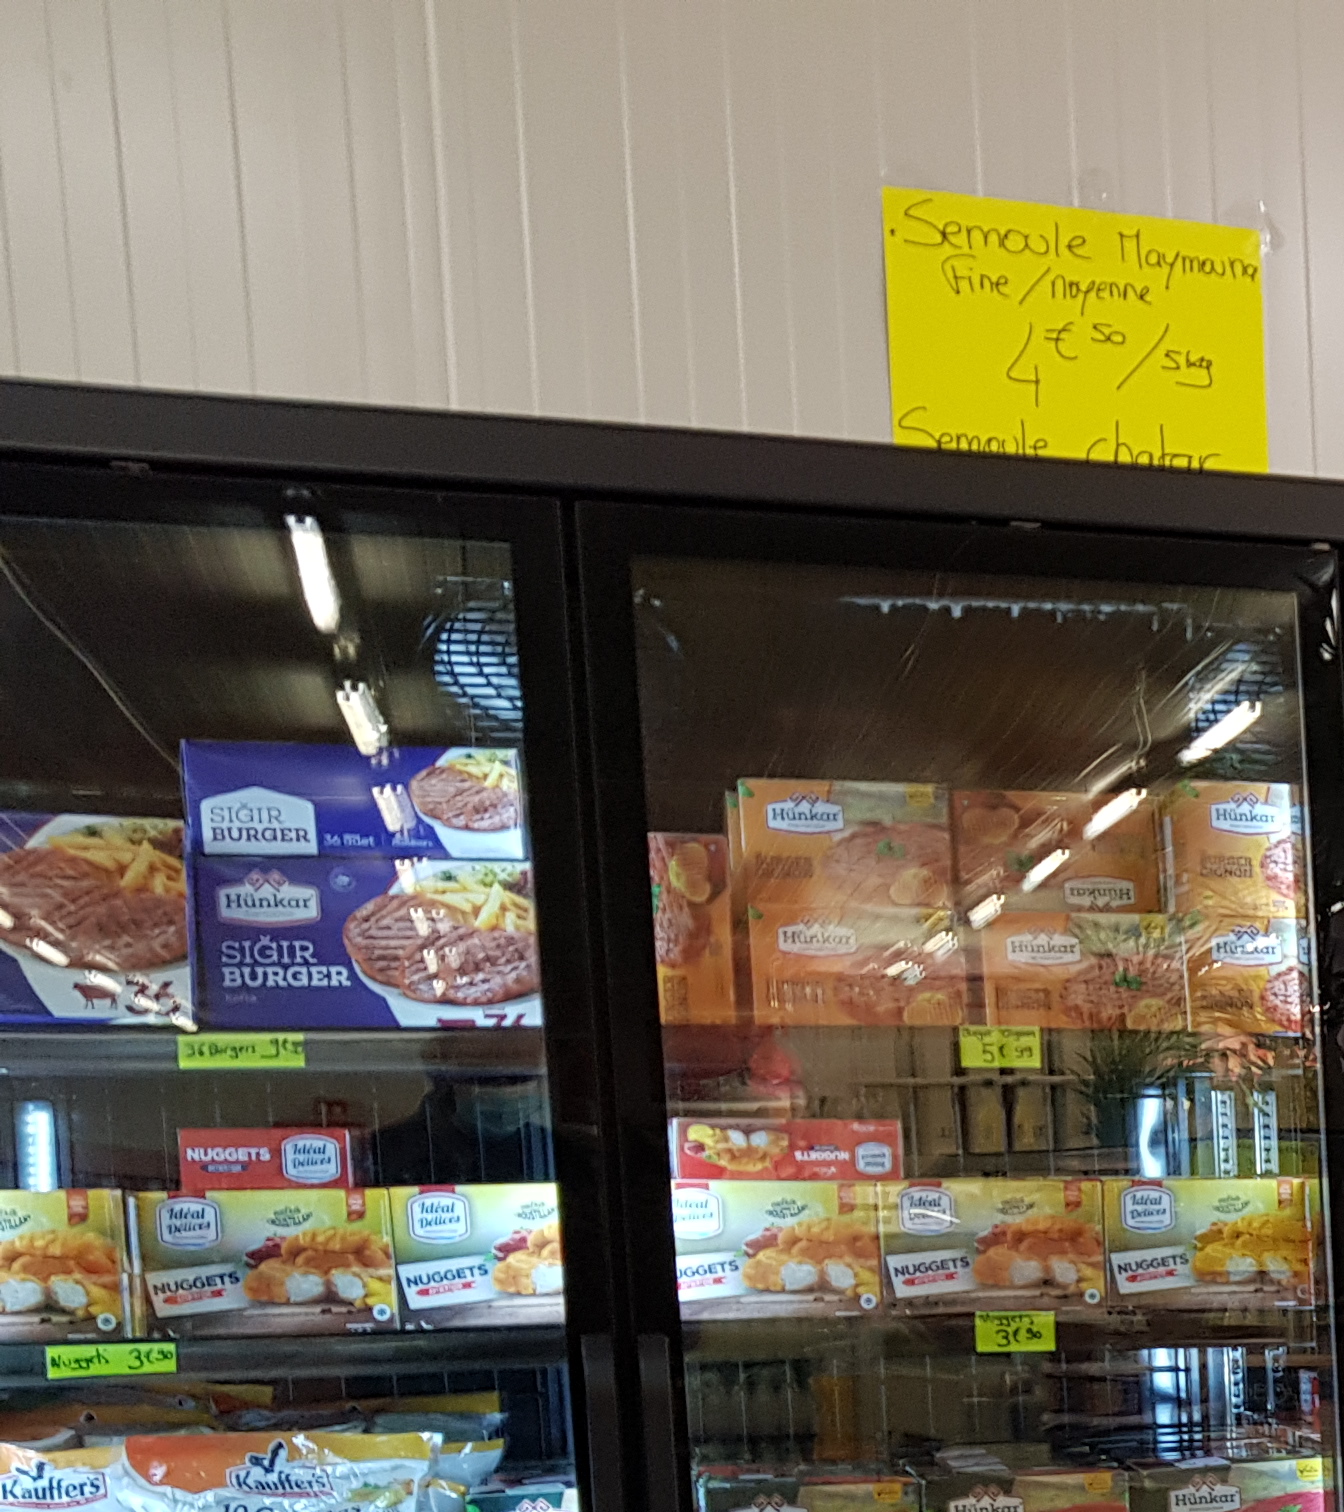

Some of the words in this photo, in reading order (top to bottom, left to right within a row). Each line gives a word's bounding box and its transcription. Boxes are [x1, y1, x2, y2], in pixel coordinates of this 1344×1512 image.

[902, 198, 1092, 260] Semoule
[771, 805, 840, 825] Hünkar
[1212, 807, 1278, 827] Hünkar
[209, 822, 312, 845] BURGER
[224, 886, 313, 912] Hünkar
[1009, 938, 1079, 958] Hünkar
[220, 964, 352, 989] BURGER
[185, 1146, 272, 1164] NUGGETS
[404, 1263, 490, 1289] NUGGETS
[892, 1254, 971, 1279] NUGGETS
[1115, 1252, 1196, 1276] NUGGETS
[152, 1270, 241, 1296] NUGGETS
[1172, 1485, 1240, 1506] Hünkar
